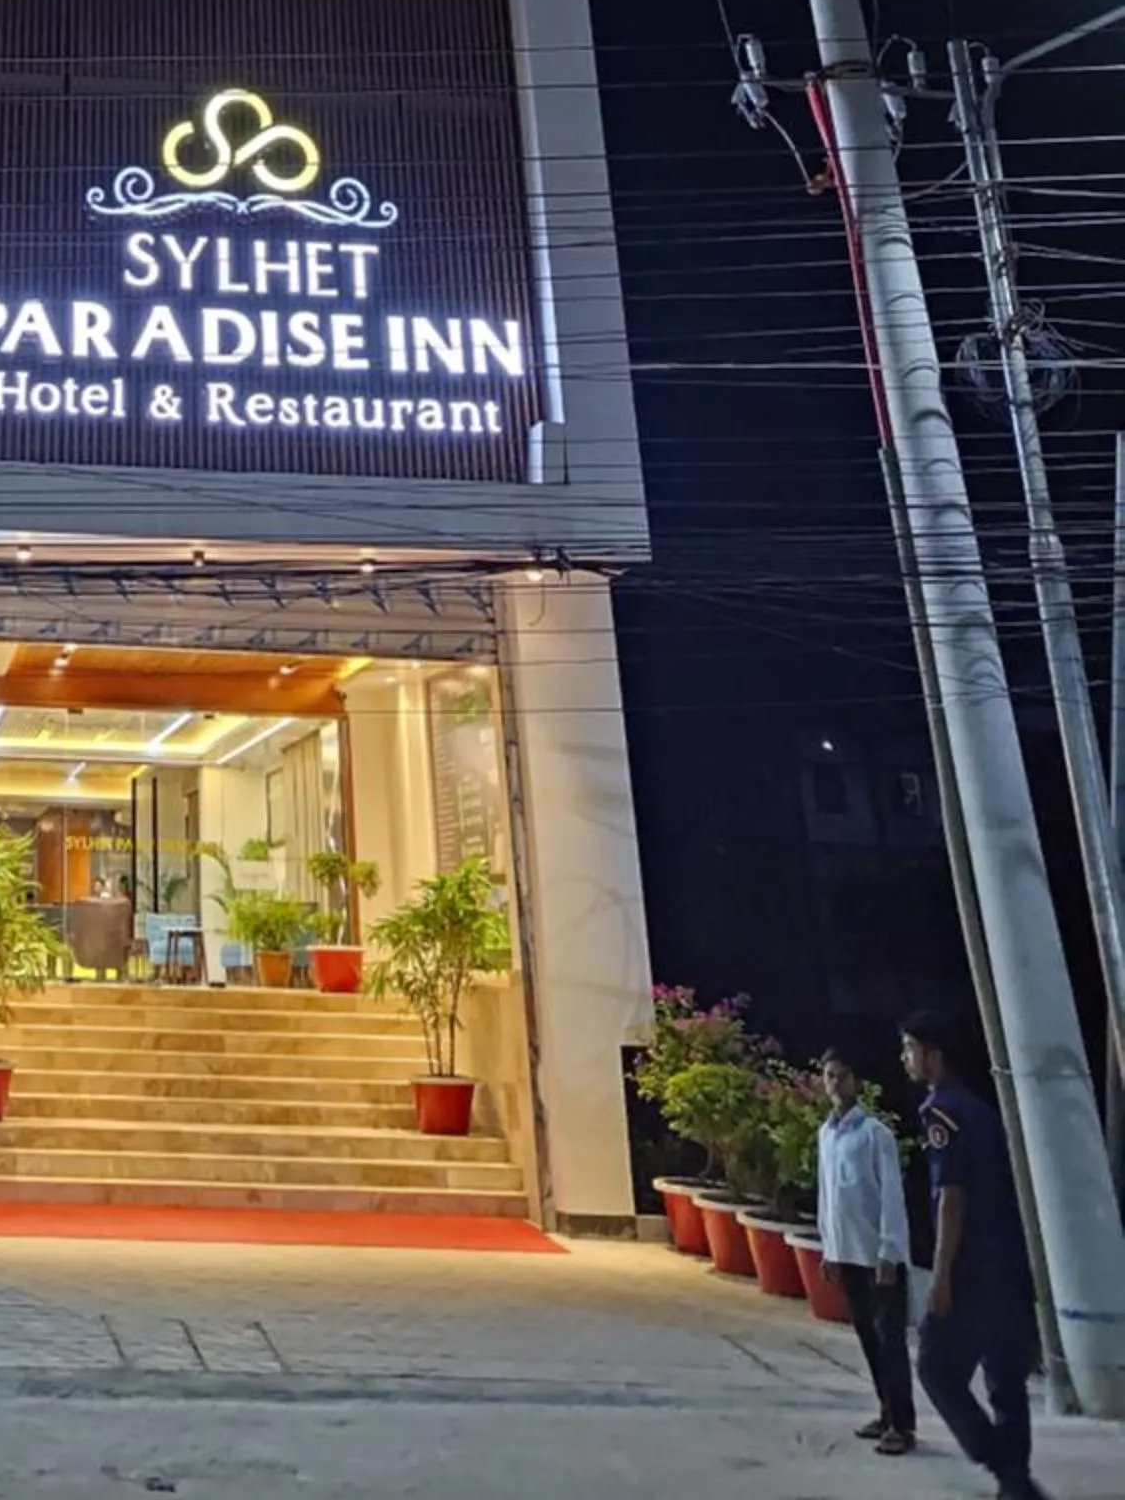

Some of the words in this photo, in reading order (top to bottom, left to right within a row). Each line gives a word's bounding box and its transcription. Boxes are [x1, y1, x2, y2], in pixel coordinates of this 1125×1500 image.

[124, 233, 379, 299] SYLHET
[386, 315, 525, 377] INN
[150, 385, 181, 421] &
[207, 383, 502, 433] Restaurant
